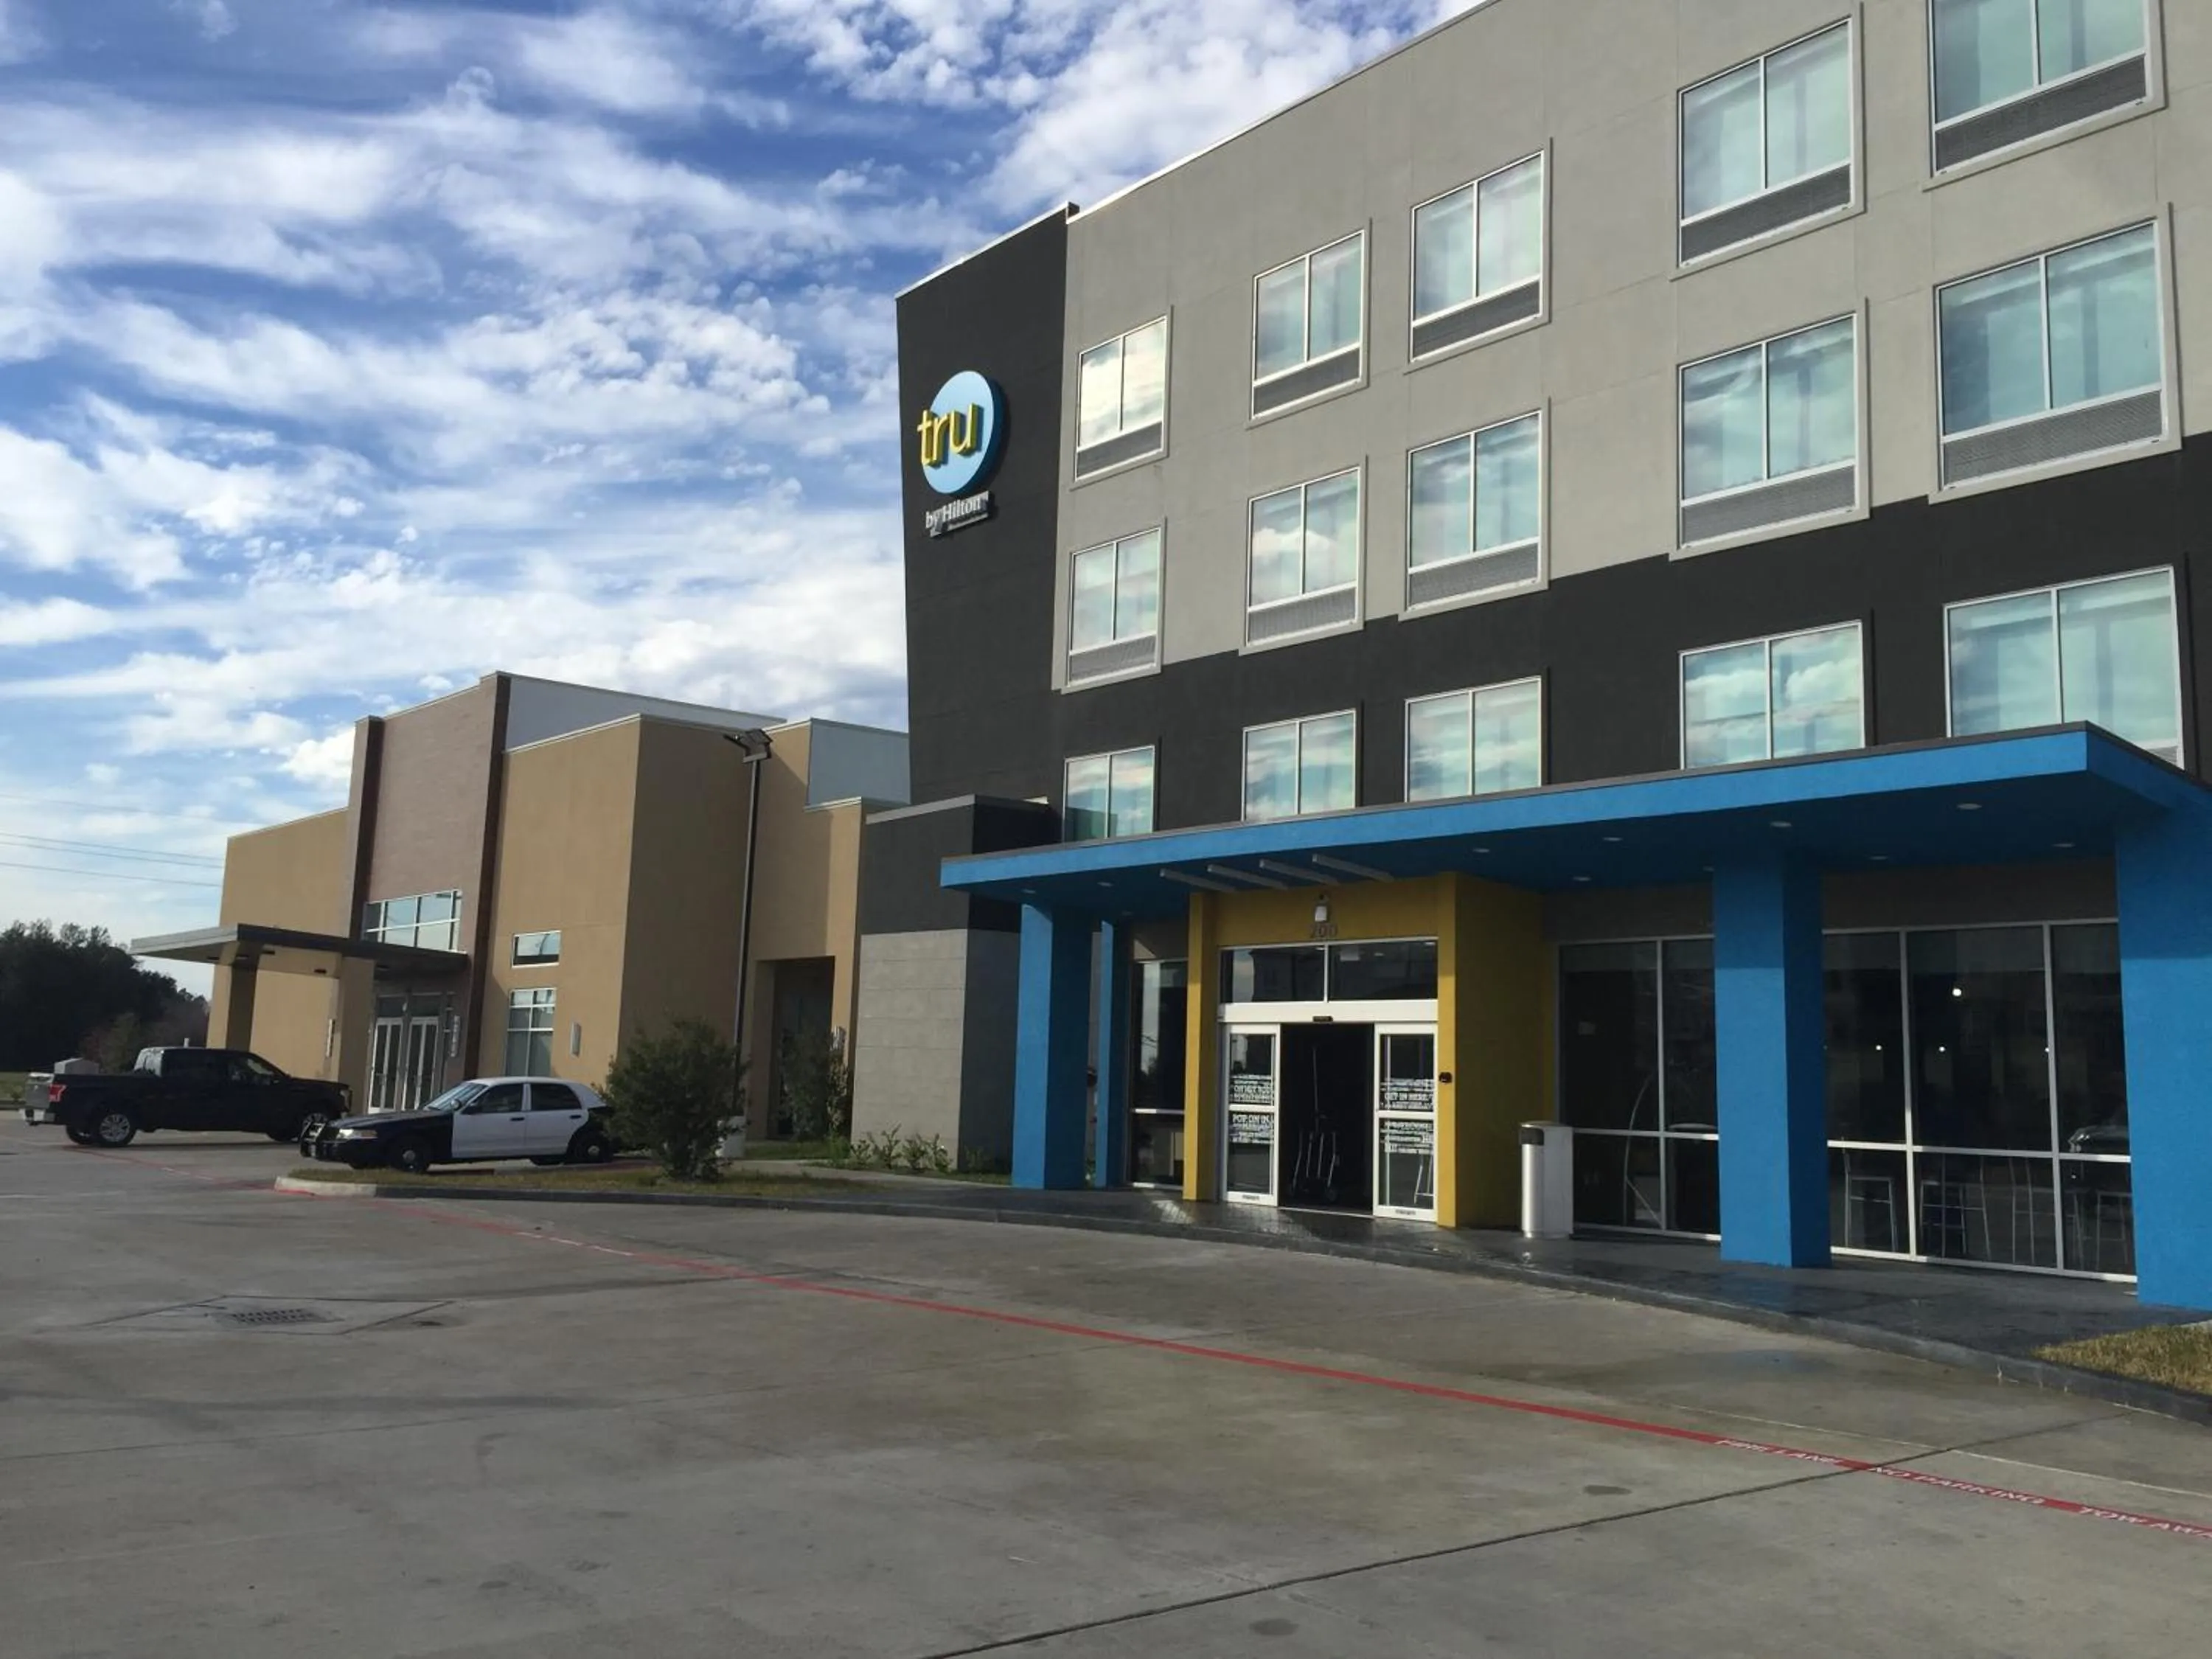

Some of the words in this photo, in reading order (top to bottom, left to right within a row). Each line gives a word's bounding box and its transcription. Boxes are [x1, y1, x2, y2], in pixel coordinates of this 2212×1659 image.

[917, 403, 978, 466] tru
[925, 510, 942, 535] by
[942, 495, 982, 522] Hilton
[1914, 1475, 2045, 1504] PARKING
[2079, 1506, 2148, 1523] TOW
